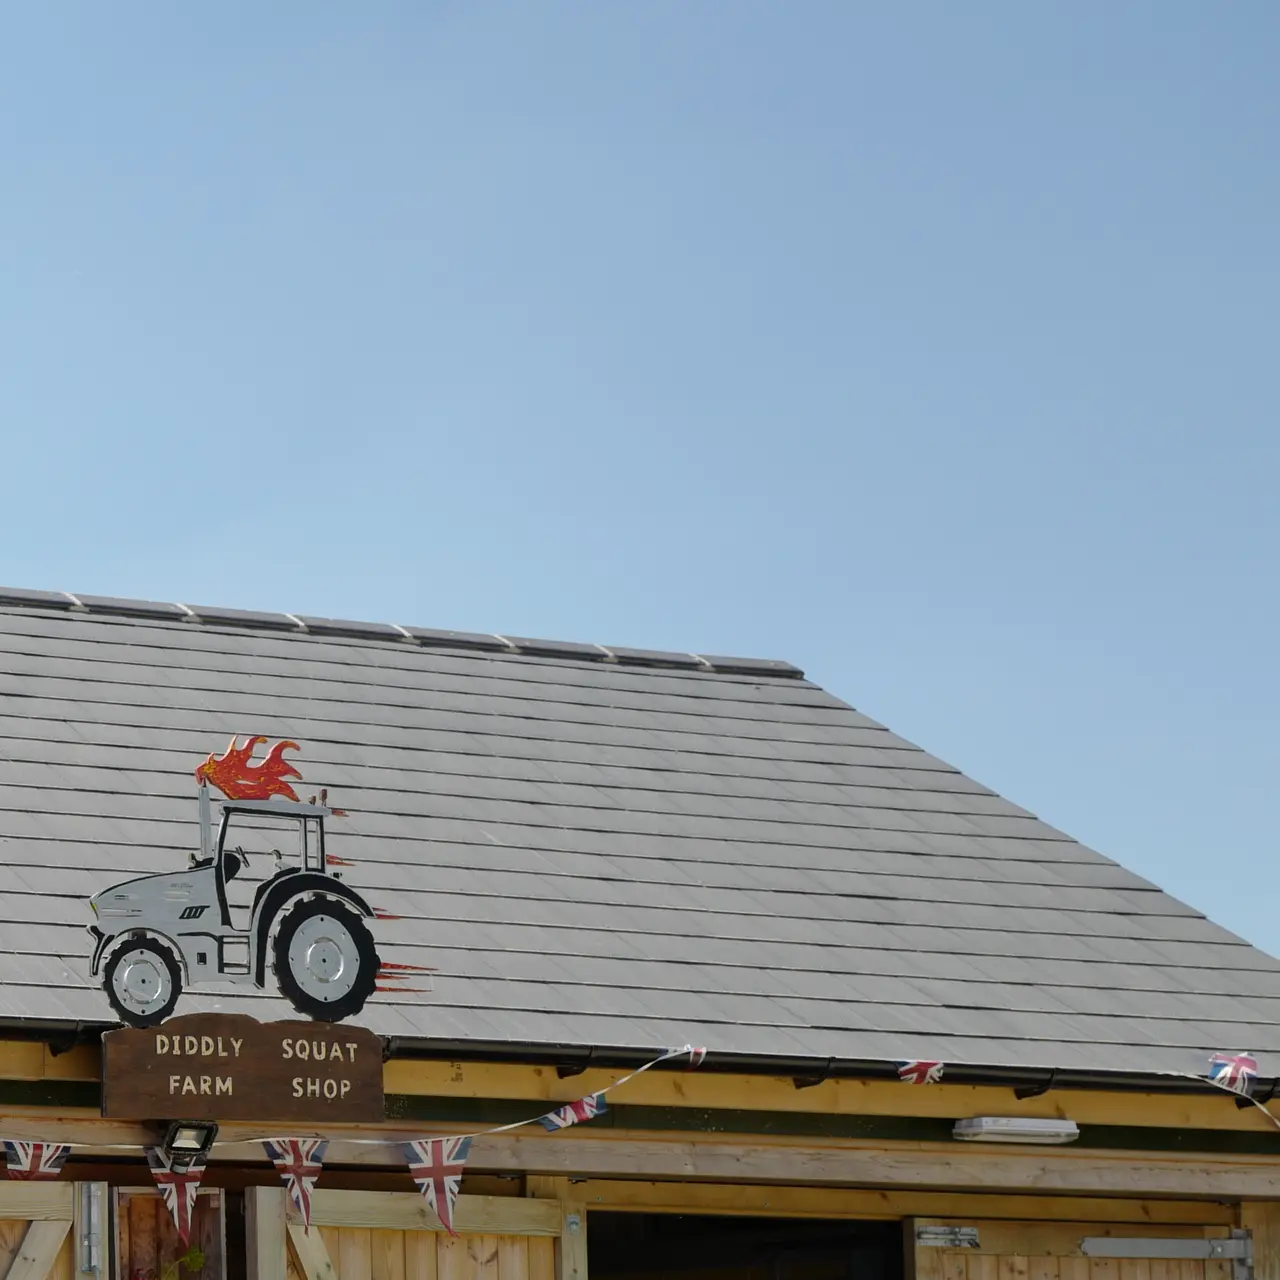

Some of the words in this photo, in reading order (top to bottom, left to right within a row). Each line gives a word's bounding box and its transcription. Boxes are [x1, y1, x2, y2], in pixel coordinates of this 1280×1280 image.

[155, 1034, 244, 1058] DIDDLY
[282, 1038, 358, 1063] SQUAT
[169, 1075, 233, 1096] FARM
[292, 1077, 352, 1100] SHOP
